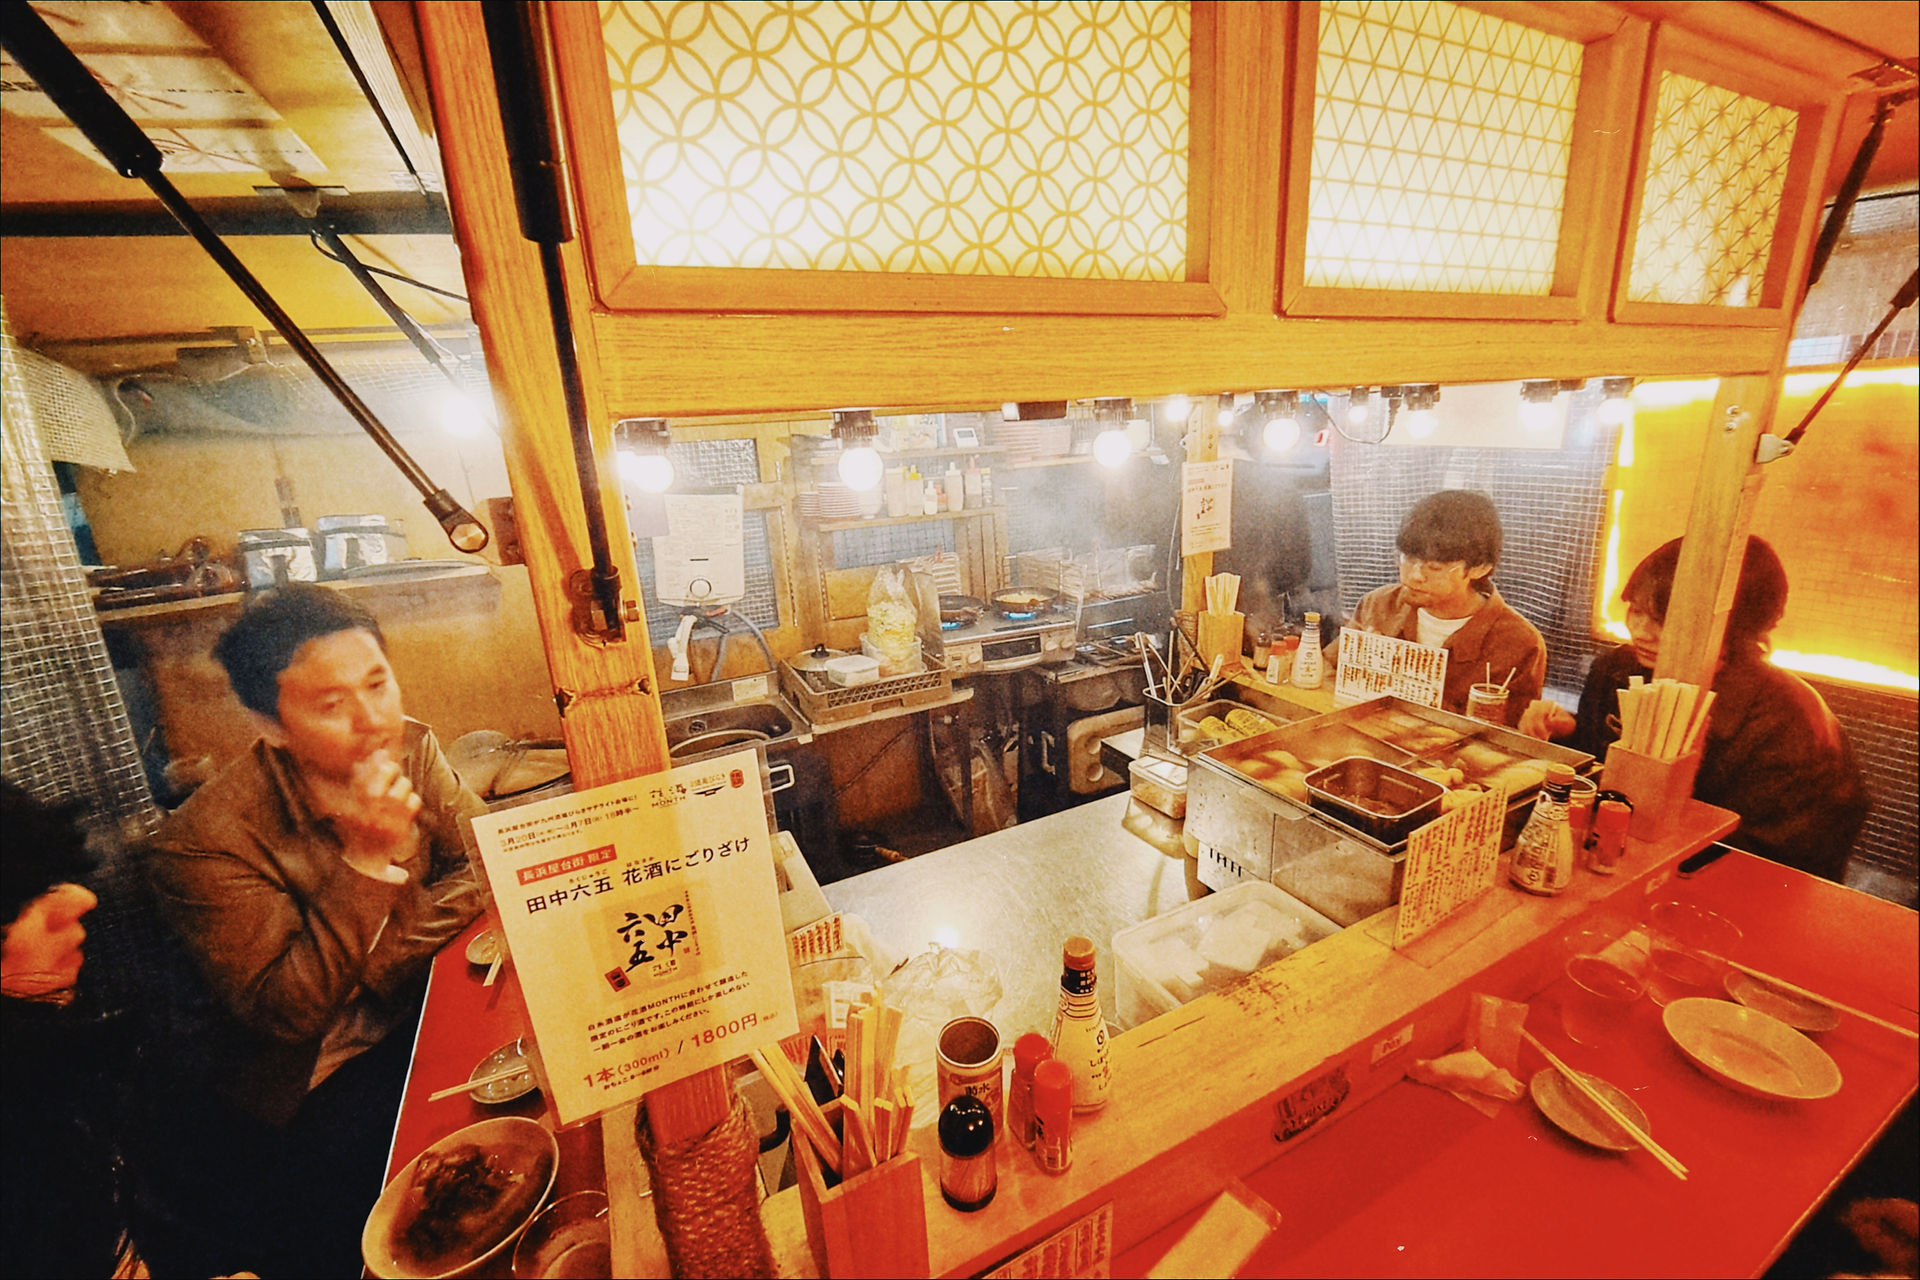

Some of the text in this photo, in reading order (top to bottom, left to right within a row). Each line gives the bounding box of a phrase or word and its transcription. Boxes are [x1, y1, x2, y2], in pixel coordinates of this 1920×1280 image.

[522, 848, 612, 881] 長浜屋台街 限定
[525, 835, 750, 914] 田中六五 花酒にごりざけ
[690, 1012, 757, 1049] 1800円
